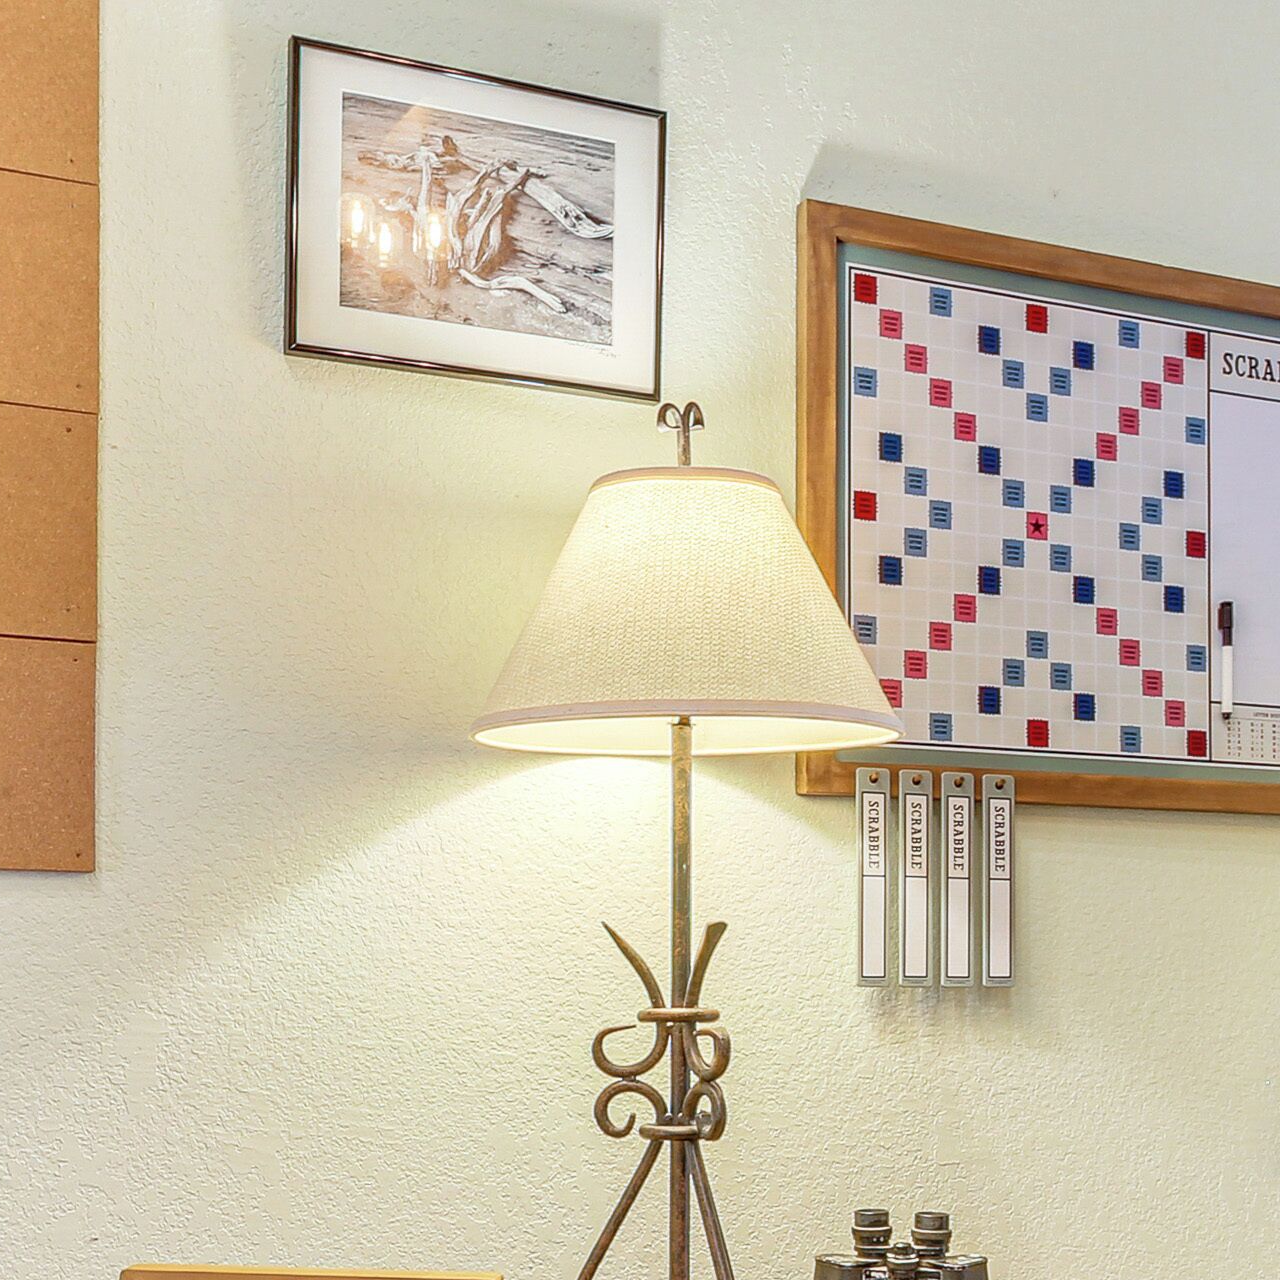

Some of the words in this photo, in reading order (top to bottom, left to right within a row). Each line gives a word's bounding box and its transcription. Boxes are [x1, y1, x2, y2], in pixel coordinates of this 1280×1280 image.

[868, 800, 880, 870] SCRABBLE
[910, 801, 923, 871] SCRABBLE
[952, 804, 965, 872] SCRABBLE
[994, 805, 1006, 873] SCRABBLE
